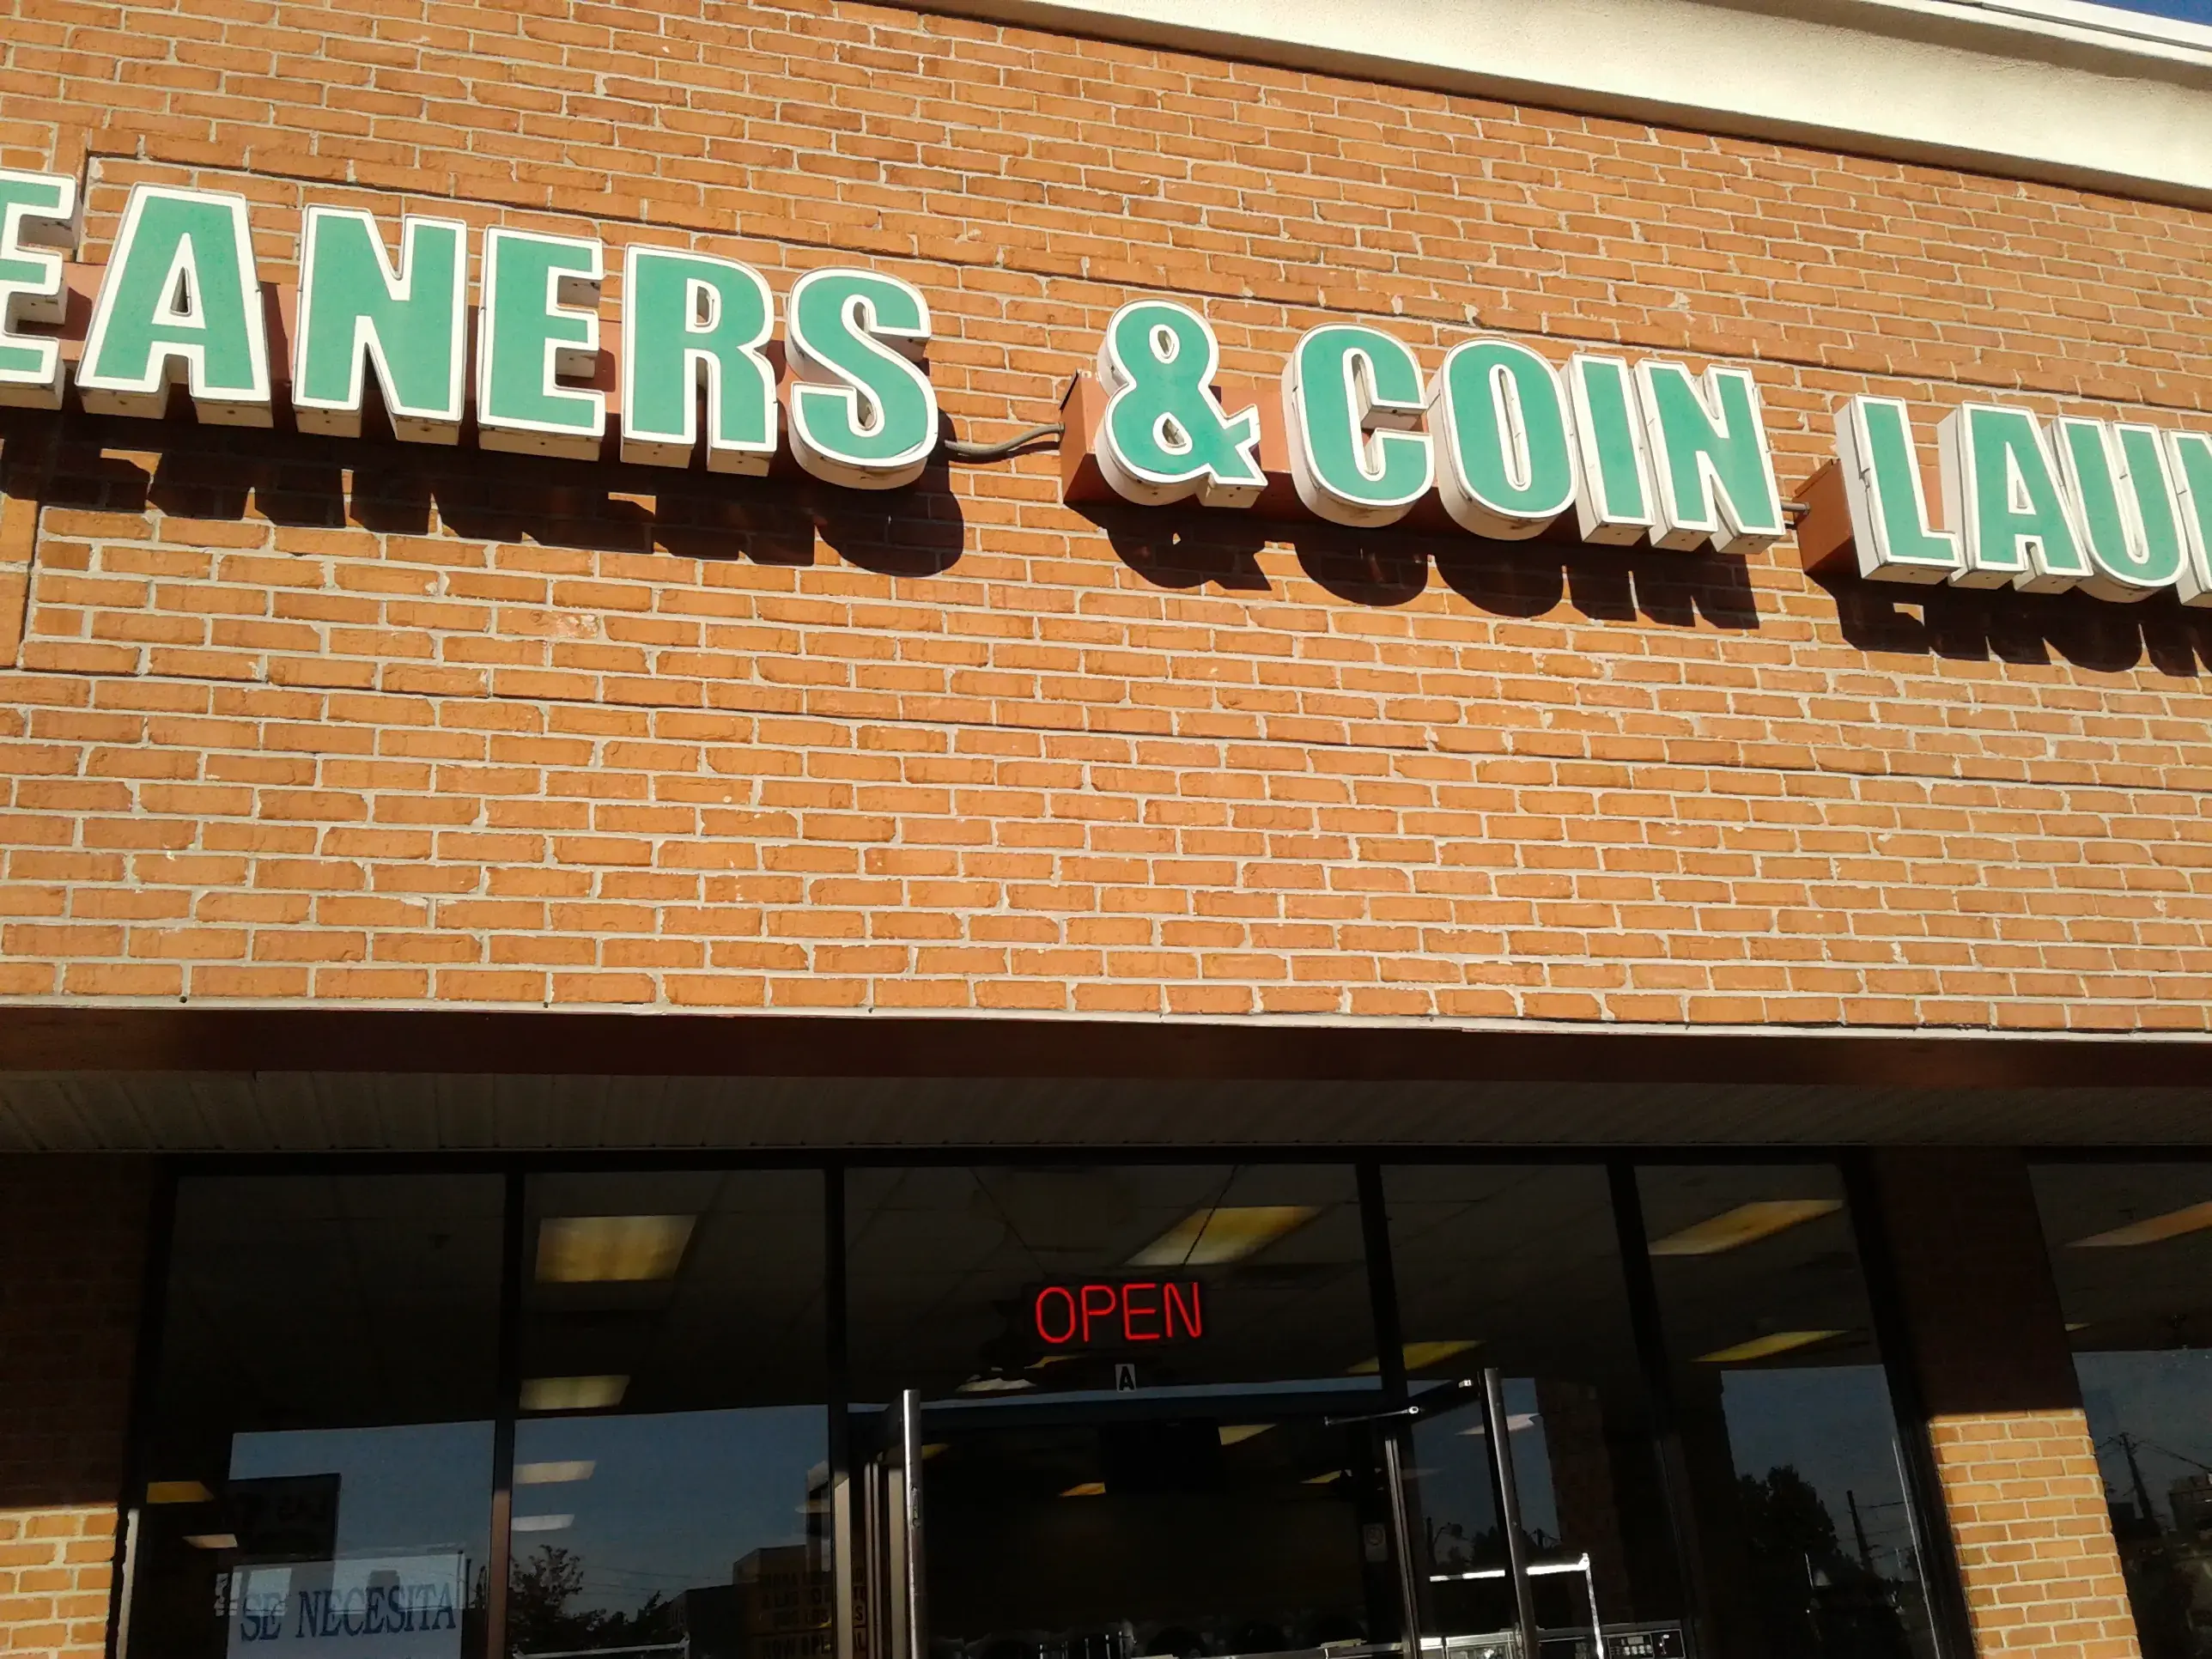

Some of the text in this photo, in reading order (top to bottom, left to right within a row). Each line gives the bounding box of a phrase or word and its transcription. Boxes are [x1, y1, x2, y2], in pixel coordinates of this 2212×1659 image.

[1101, 298, 1269, 491] &
[1288, 322, 1785, 538] COIN
[1035, 1281, 1202, 1344] OPEN
[1117, 1364, 1136, 1392] A
[240, 1582, 457, 1642] SE NECESITA
